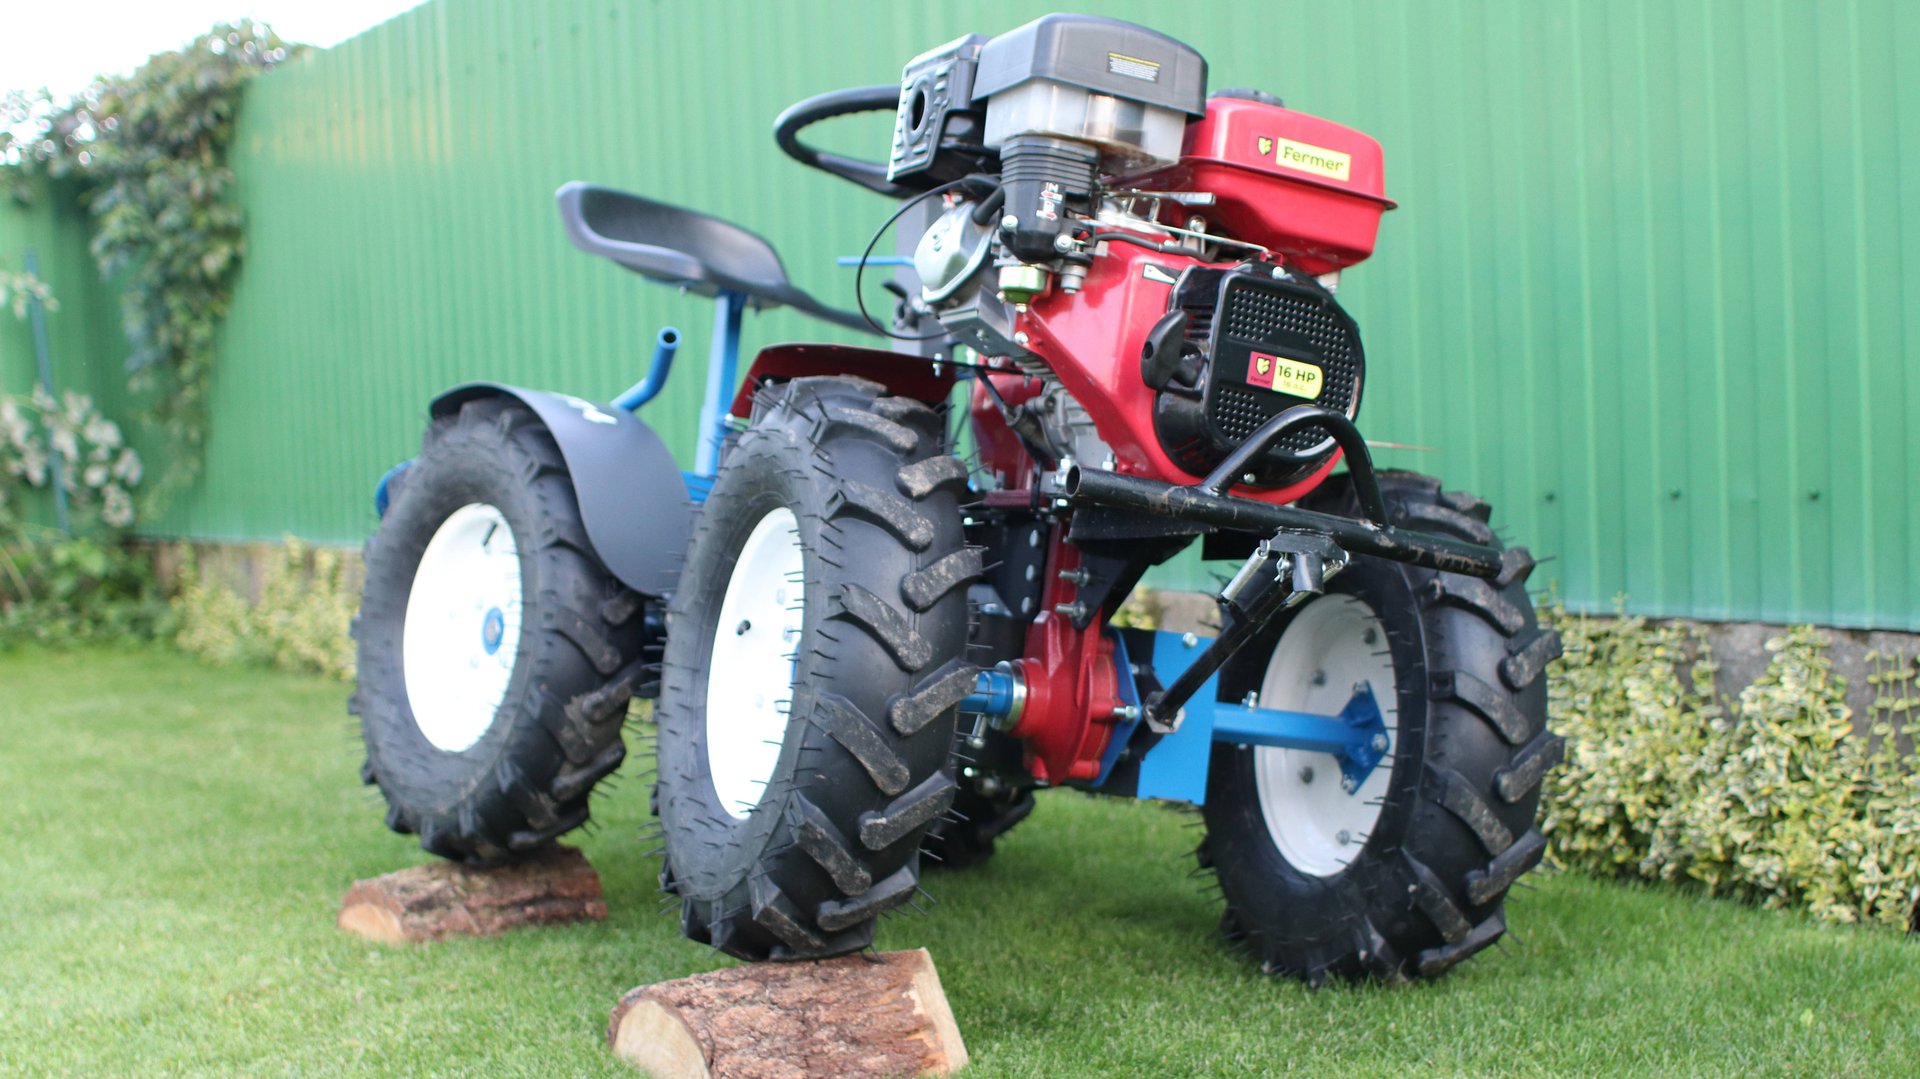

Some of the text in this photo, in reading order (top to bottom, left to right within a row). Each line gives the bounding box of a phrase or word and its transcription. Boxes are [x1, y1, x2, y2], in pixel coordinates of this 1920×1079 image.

[1283, 146, 1343, 171] Fermer
[1279, 365, 1316, 382] 16 HP
